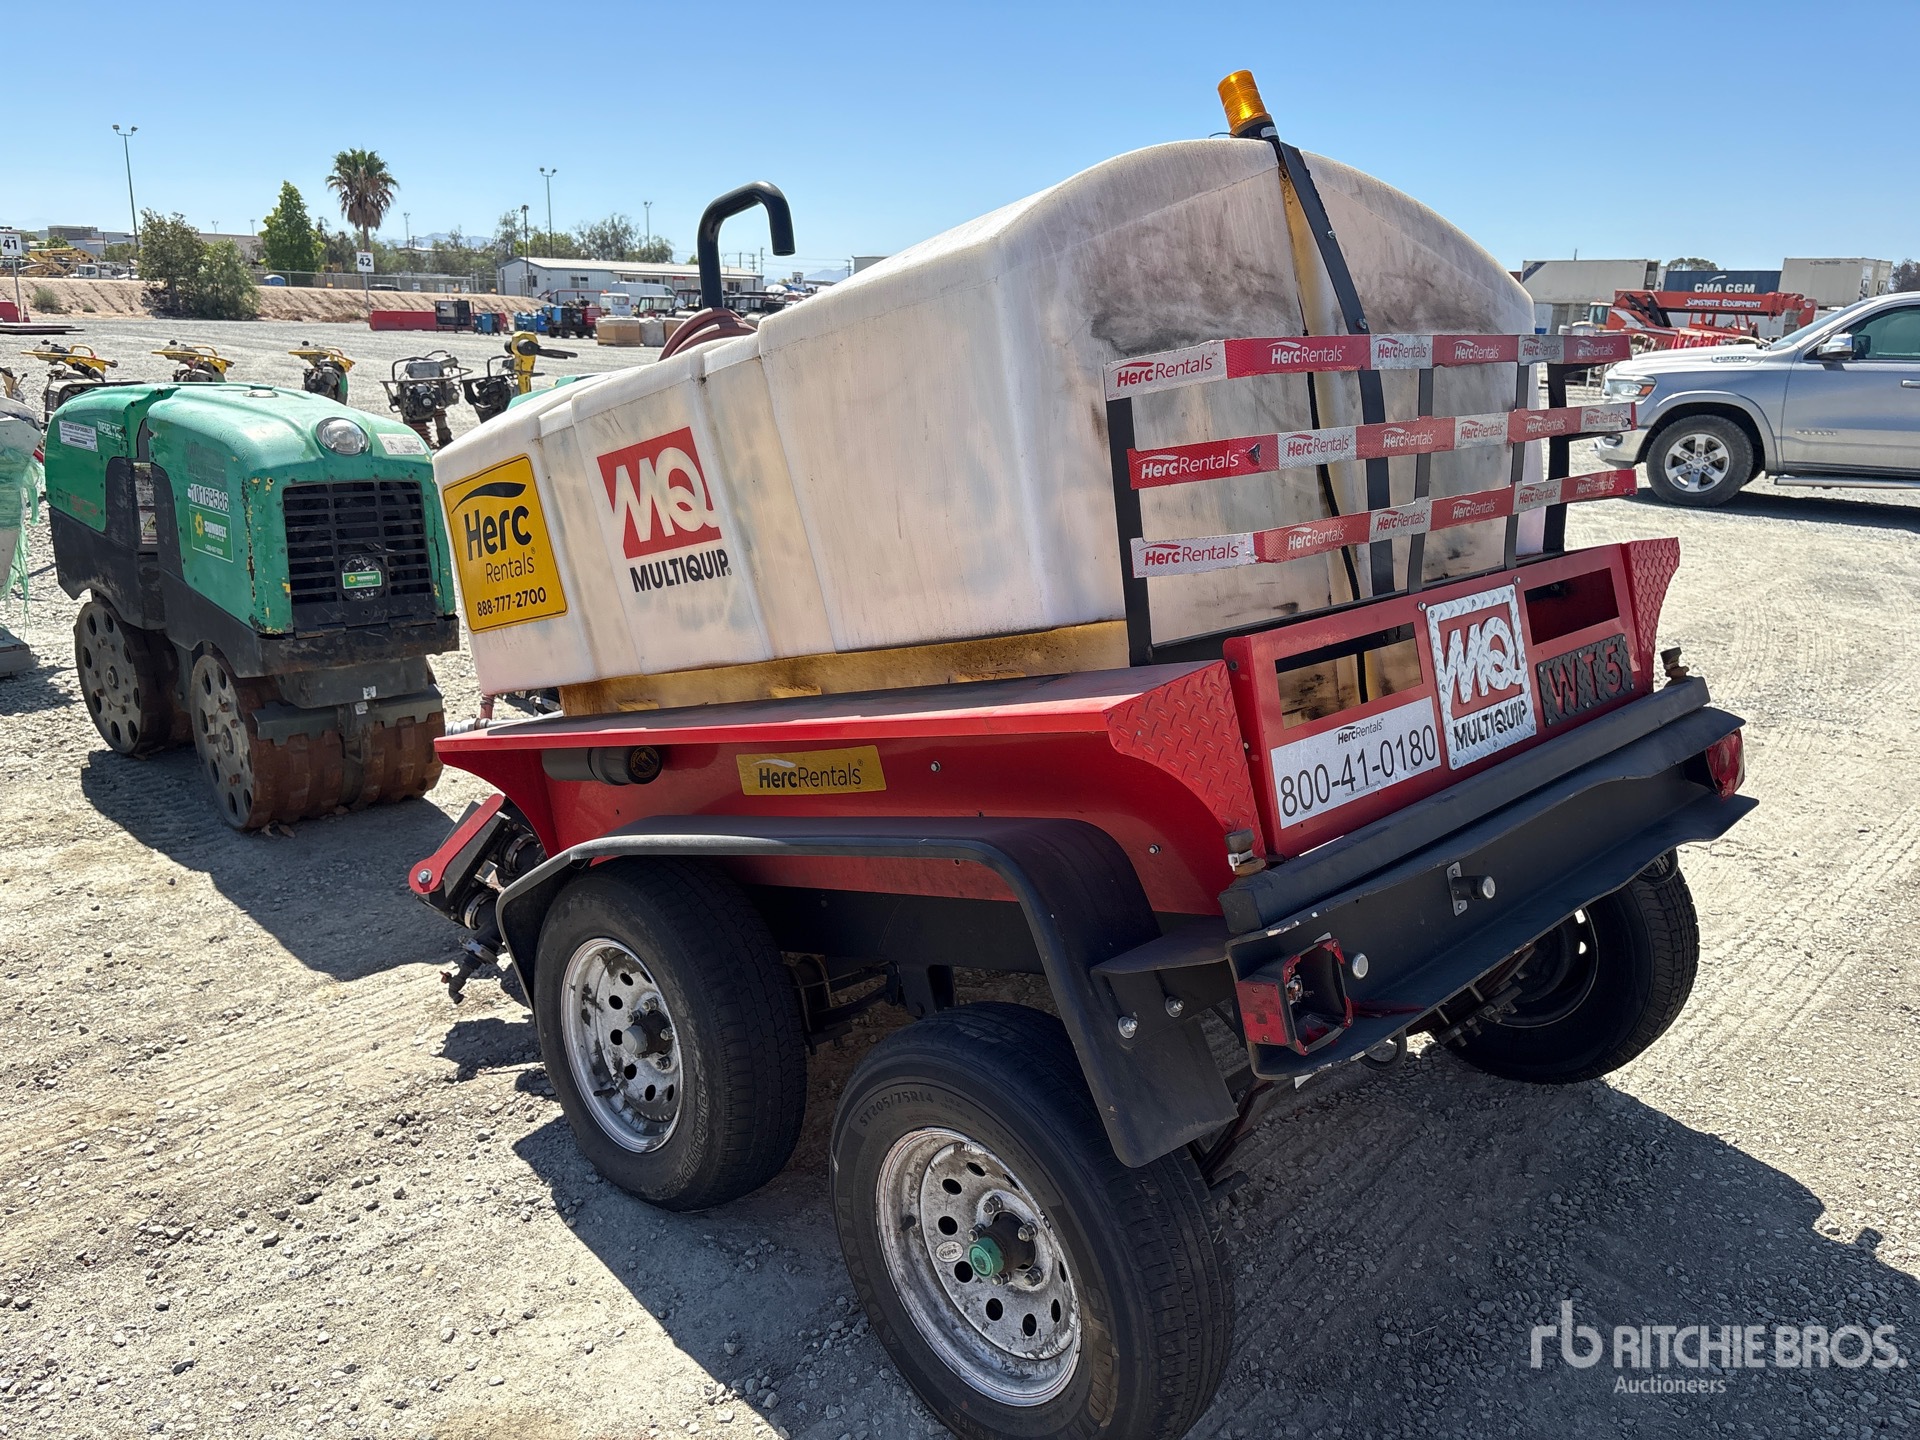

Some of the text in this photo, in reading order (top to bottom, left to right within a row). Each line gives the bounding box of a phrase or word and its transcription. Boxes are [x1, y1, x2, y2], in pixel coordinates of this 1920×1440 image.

[3, 240, 17, 250] 41
[359, 258, 371, 266] 42
[1694, 283, 1756, 293] CMA CGM
[613, 446, 719, 543] MQ
[464, 505, 532, 561] Herc
[486, 552, 535, 584] Rentals
[629, 549, 729, 593] MULTIQUIP
[477, 587, 546, 617] 888-777-2700
[1445, 616, 1525, 704] MQ
[1453, 700, 1528, 752] MULTIQUIP
[1280, 724, 1436, 817] 800-41-0180
[859, 1090, 934, 1127] ST205/75R14
